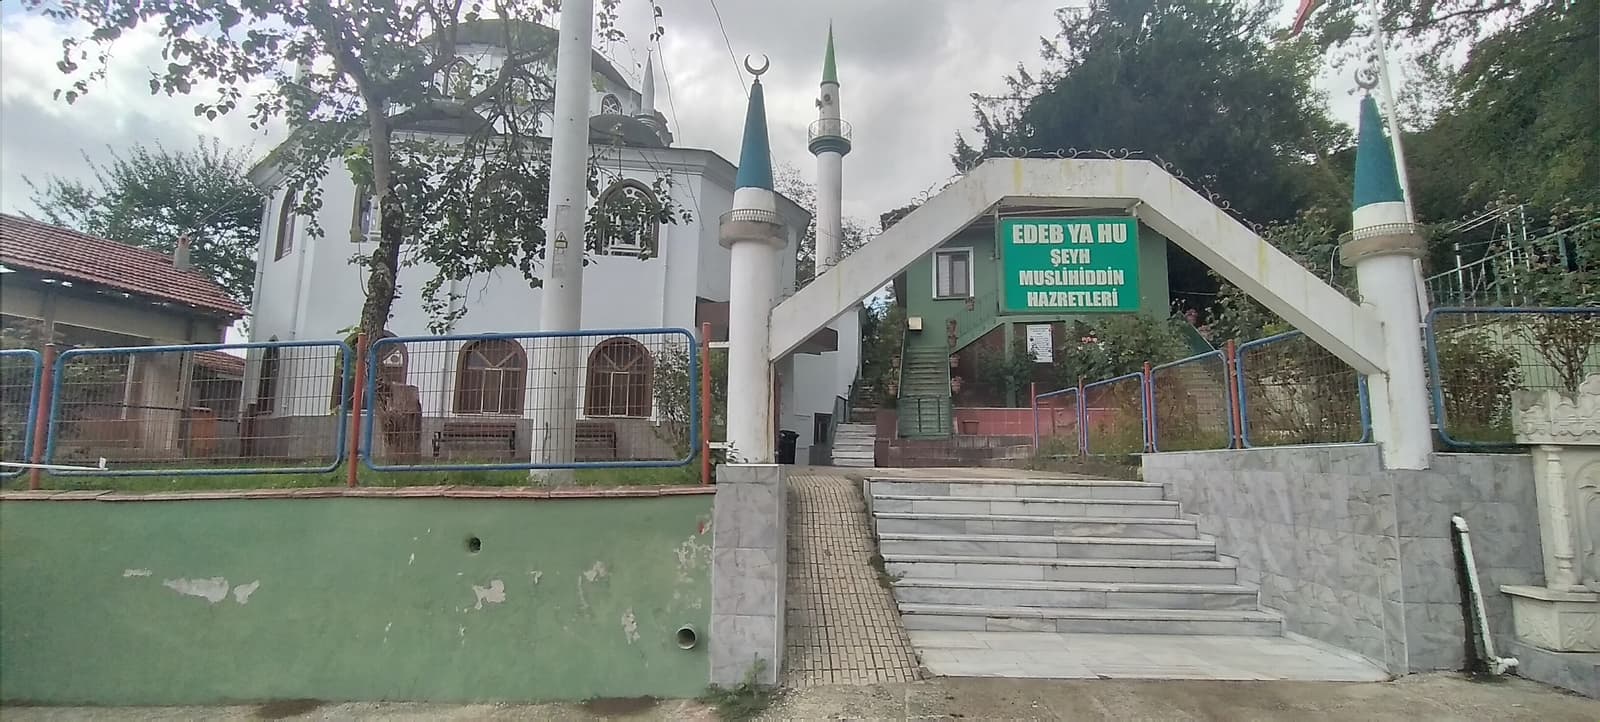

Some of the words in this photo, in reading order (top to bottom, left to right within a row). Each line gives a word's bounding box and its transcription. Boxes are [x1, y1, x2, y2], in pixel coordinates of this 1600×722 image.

[1013, 224, 1063, 244] EDEB
[1068, 223, 1094, 243] YA
[1098, 223, 1127, 243] HU
[1050, 248, 1091, 267] ŞEYH
[1019, 266, 1125, 286] MUSLİHİDDİN
[1027, 288, 1118, 307] HAZRETLERİ
